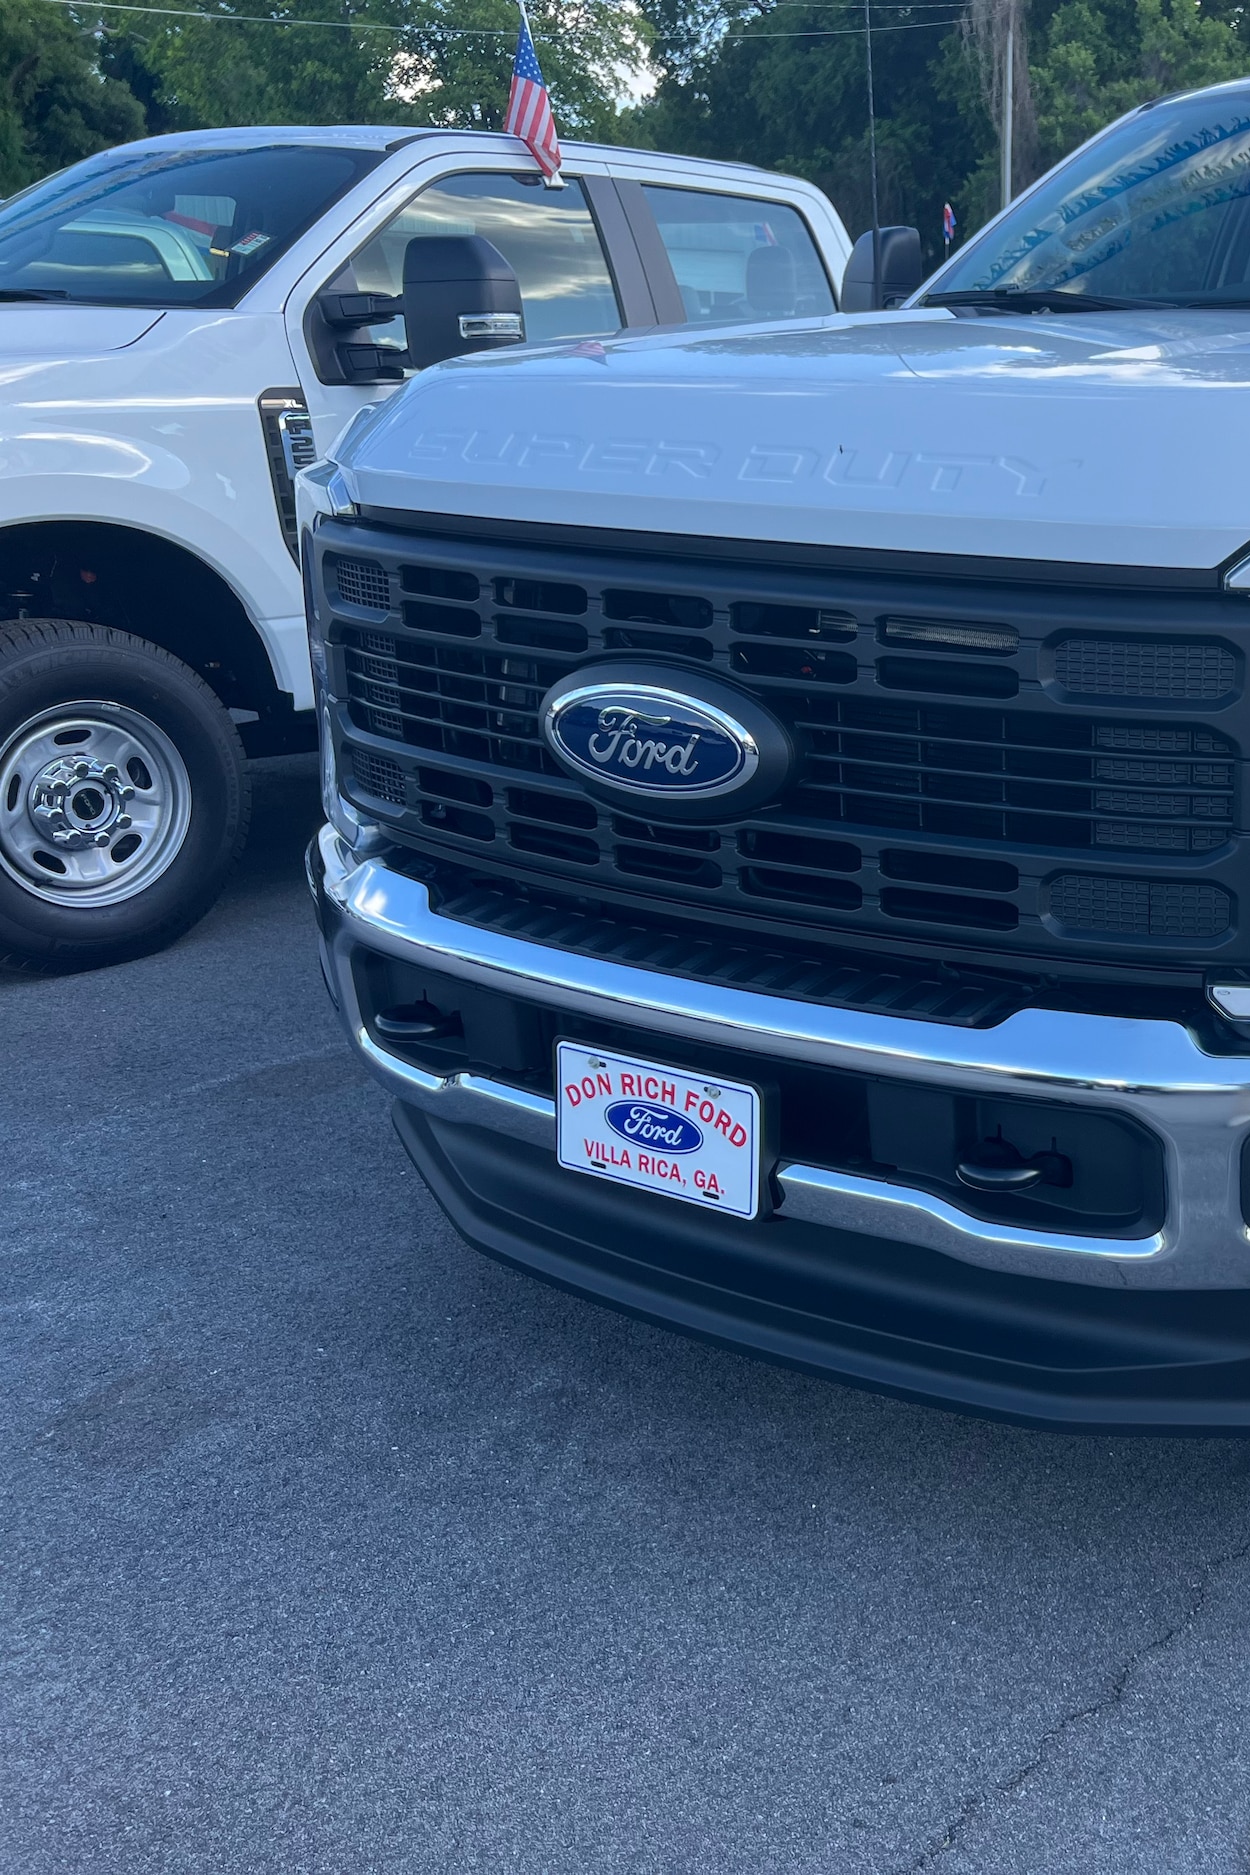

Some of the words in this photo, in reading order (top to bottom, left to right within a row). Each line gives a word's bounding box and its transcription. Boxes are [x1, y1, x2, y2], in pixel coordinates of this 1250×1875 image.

[283, 399, 306, 409] XL
[407, 429, 723, 480] SUPER
[736, 443, 1085, 497] DUTY
[588, 706, 700, 776] Ford
[565, 1073, 612, 1107] DON
[620, 1073, 676, 1105] RICH
[684, 1091, 747, 1148] FORD
[623, 1106, 684, 1146] Ford
[584, 1139, 631, 1168] VILLA
[638, 1153, 687, 1188] RICA,
[693, 1169, 725, 1195] GA.
